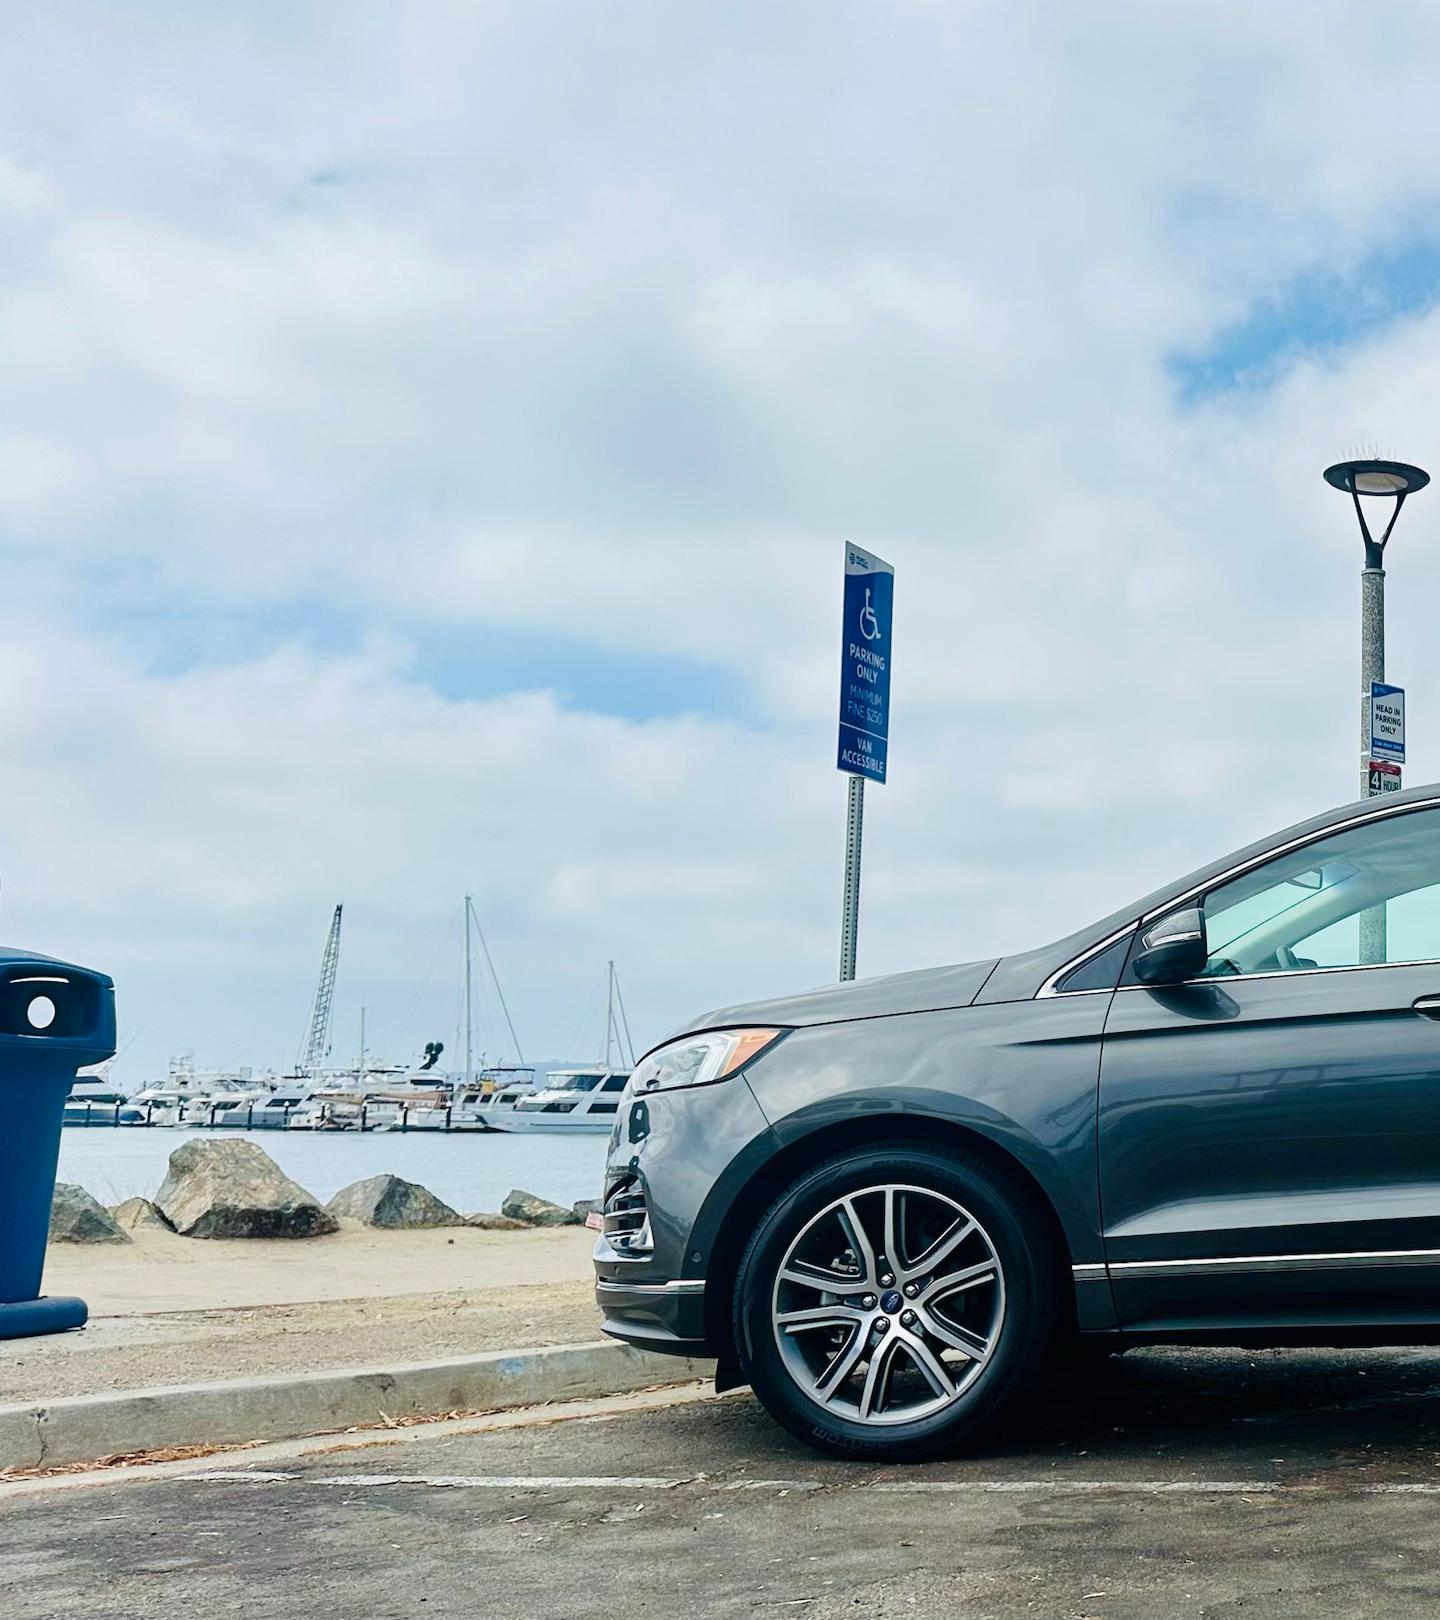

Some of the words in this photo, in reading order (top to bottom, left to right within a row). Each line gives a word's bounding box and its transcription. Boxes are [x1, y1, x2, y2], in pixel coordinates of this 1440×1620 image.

[850, 643, 885, 670] PARKING
[857, 664, 878, 684] ONLY
[848, 700, 864, 718] FINE
[1376, 704, 1392, 714] HEAD
[1394, 707, 1401, 716] IN
[1376, 713, 1401, 726] PARKING
[1381, 725, 1396, 734] ONLY
[858, 737, 872, 753] VAN
[842, 749, 883, 773] ACCESSIBLE
[1371, 771, 1379, 788] 4
[1383, 778, 1398, 792] HOUR
